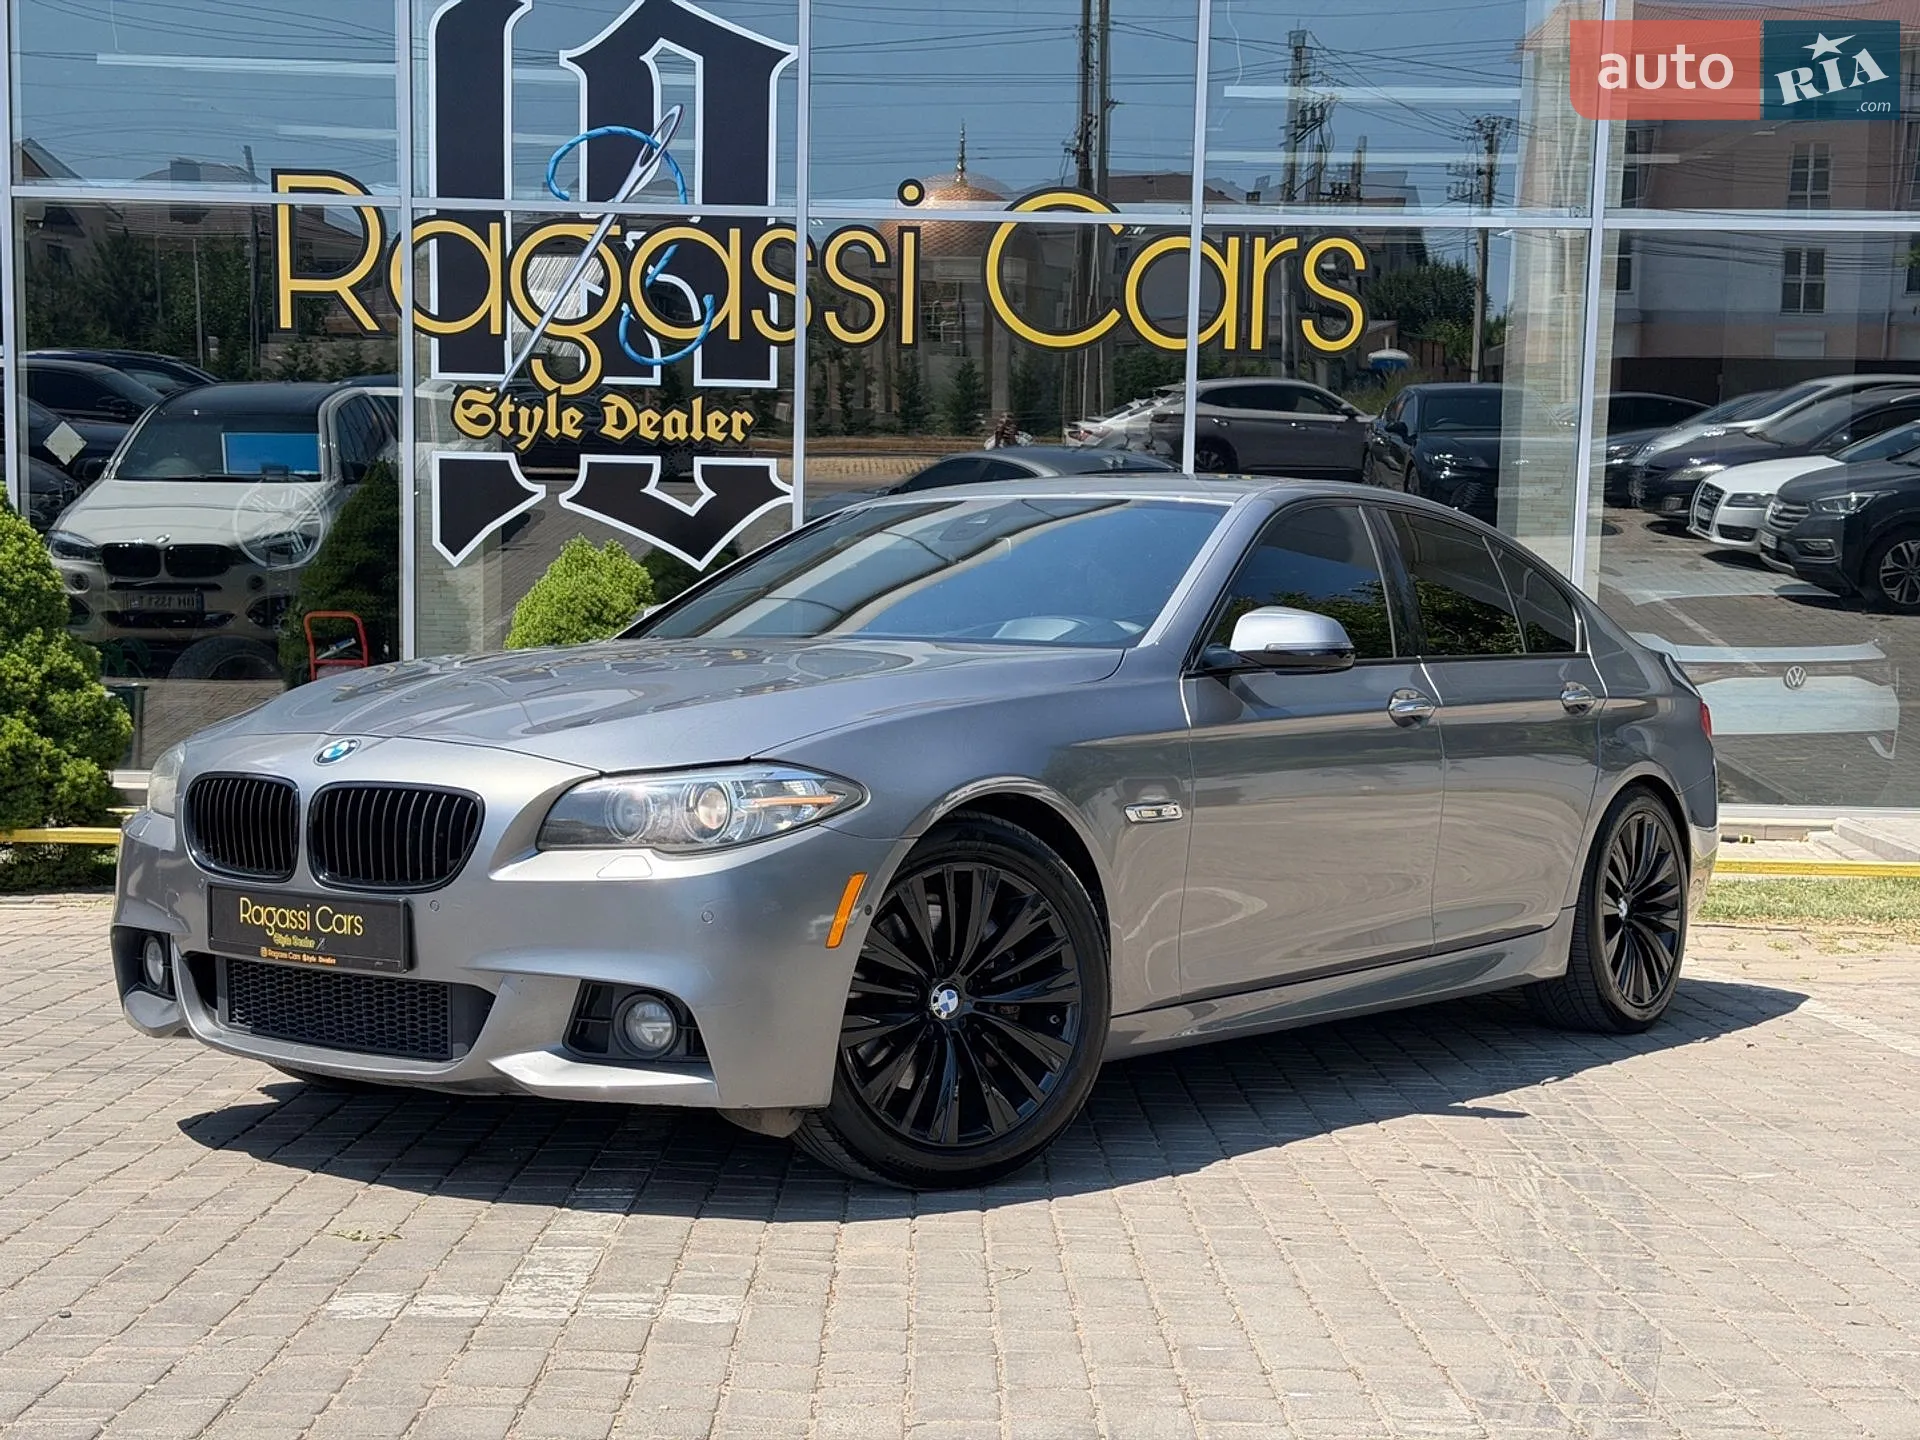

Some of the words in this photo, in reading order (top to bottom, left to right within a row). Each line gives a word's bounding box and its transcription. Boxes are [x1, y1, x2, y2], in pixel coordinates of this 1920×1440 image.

[272, 169, 920, 395] Ragassi
[983, 188, 1369, 355] Cars
[451, 388, 586, 452] Style
[600, 393, 756, 444] Dealer
[239, 896, 311, 936] Ragassi
[315, 905, 364, 937] Cars
